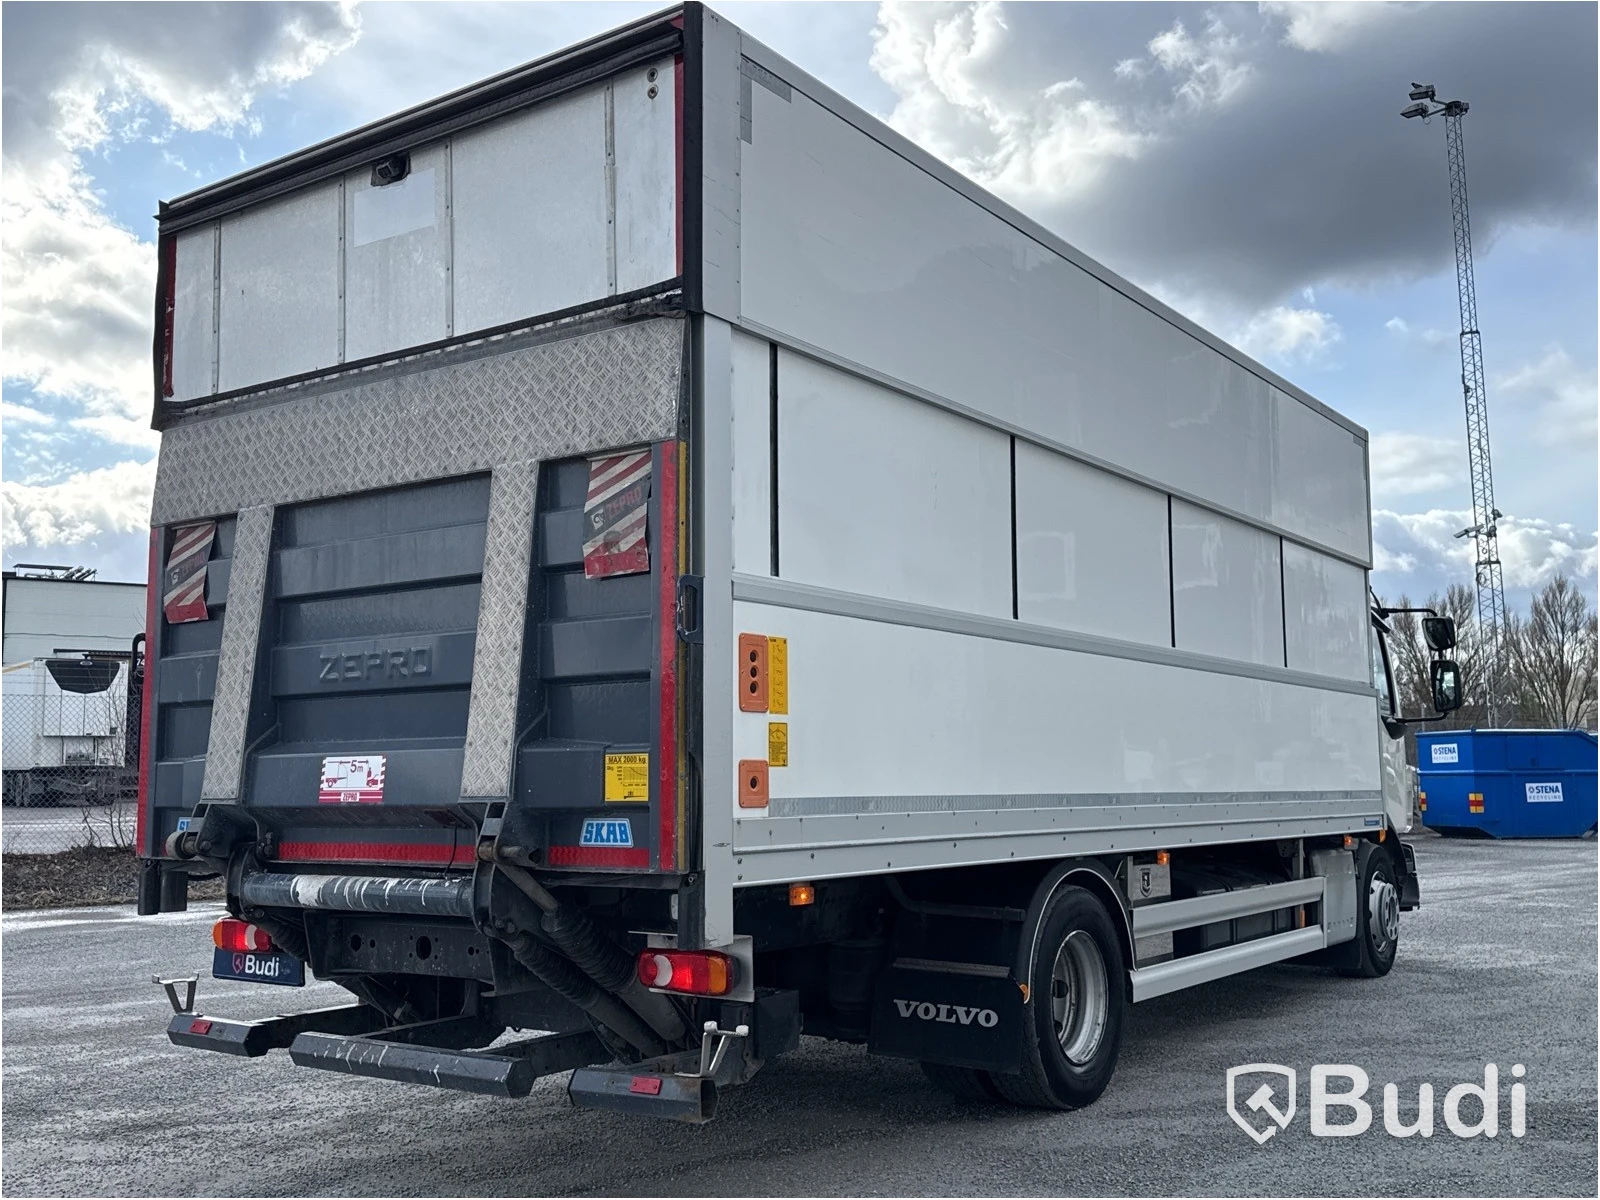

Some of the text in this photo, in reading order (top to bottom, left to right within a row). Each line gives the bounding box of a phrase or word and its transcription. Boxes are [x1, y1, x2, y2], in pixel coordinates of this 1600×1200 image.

[605, 485, 643, 521] ZEPRO
[319, 646, 432, 680] ZEPRO
[623, 755, 637, 763] 2000
[639, 756, 646, 764] kg
[1438, 747, 1456, 755] STENA
[1535, 785, 1560, 794] STENA
[583, 822, 630, 843] SKAB
[244, 954, 280, 977] Budi
[893, 999, 999, 1028] VOLVO
